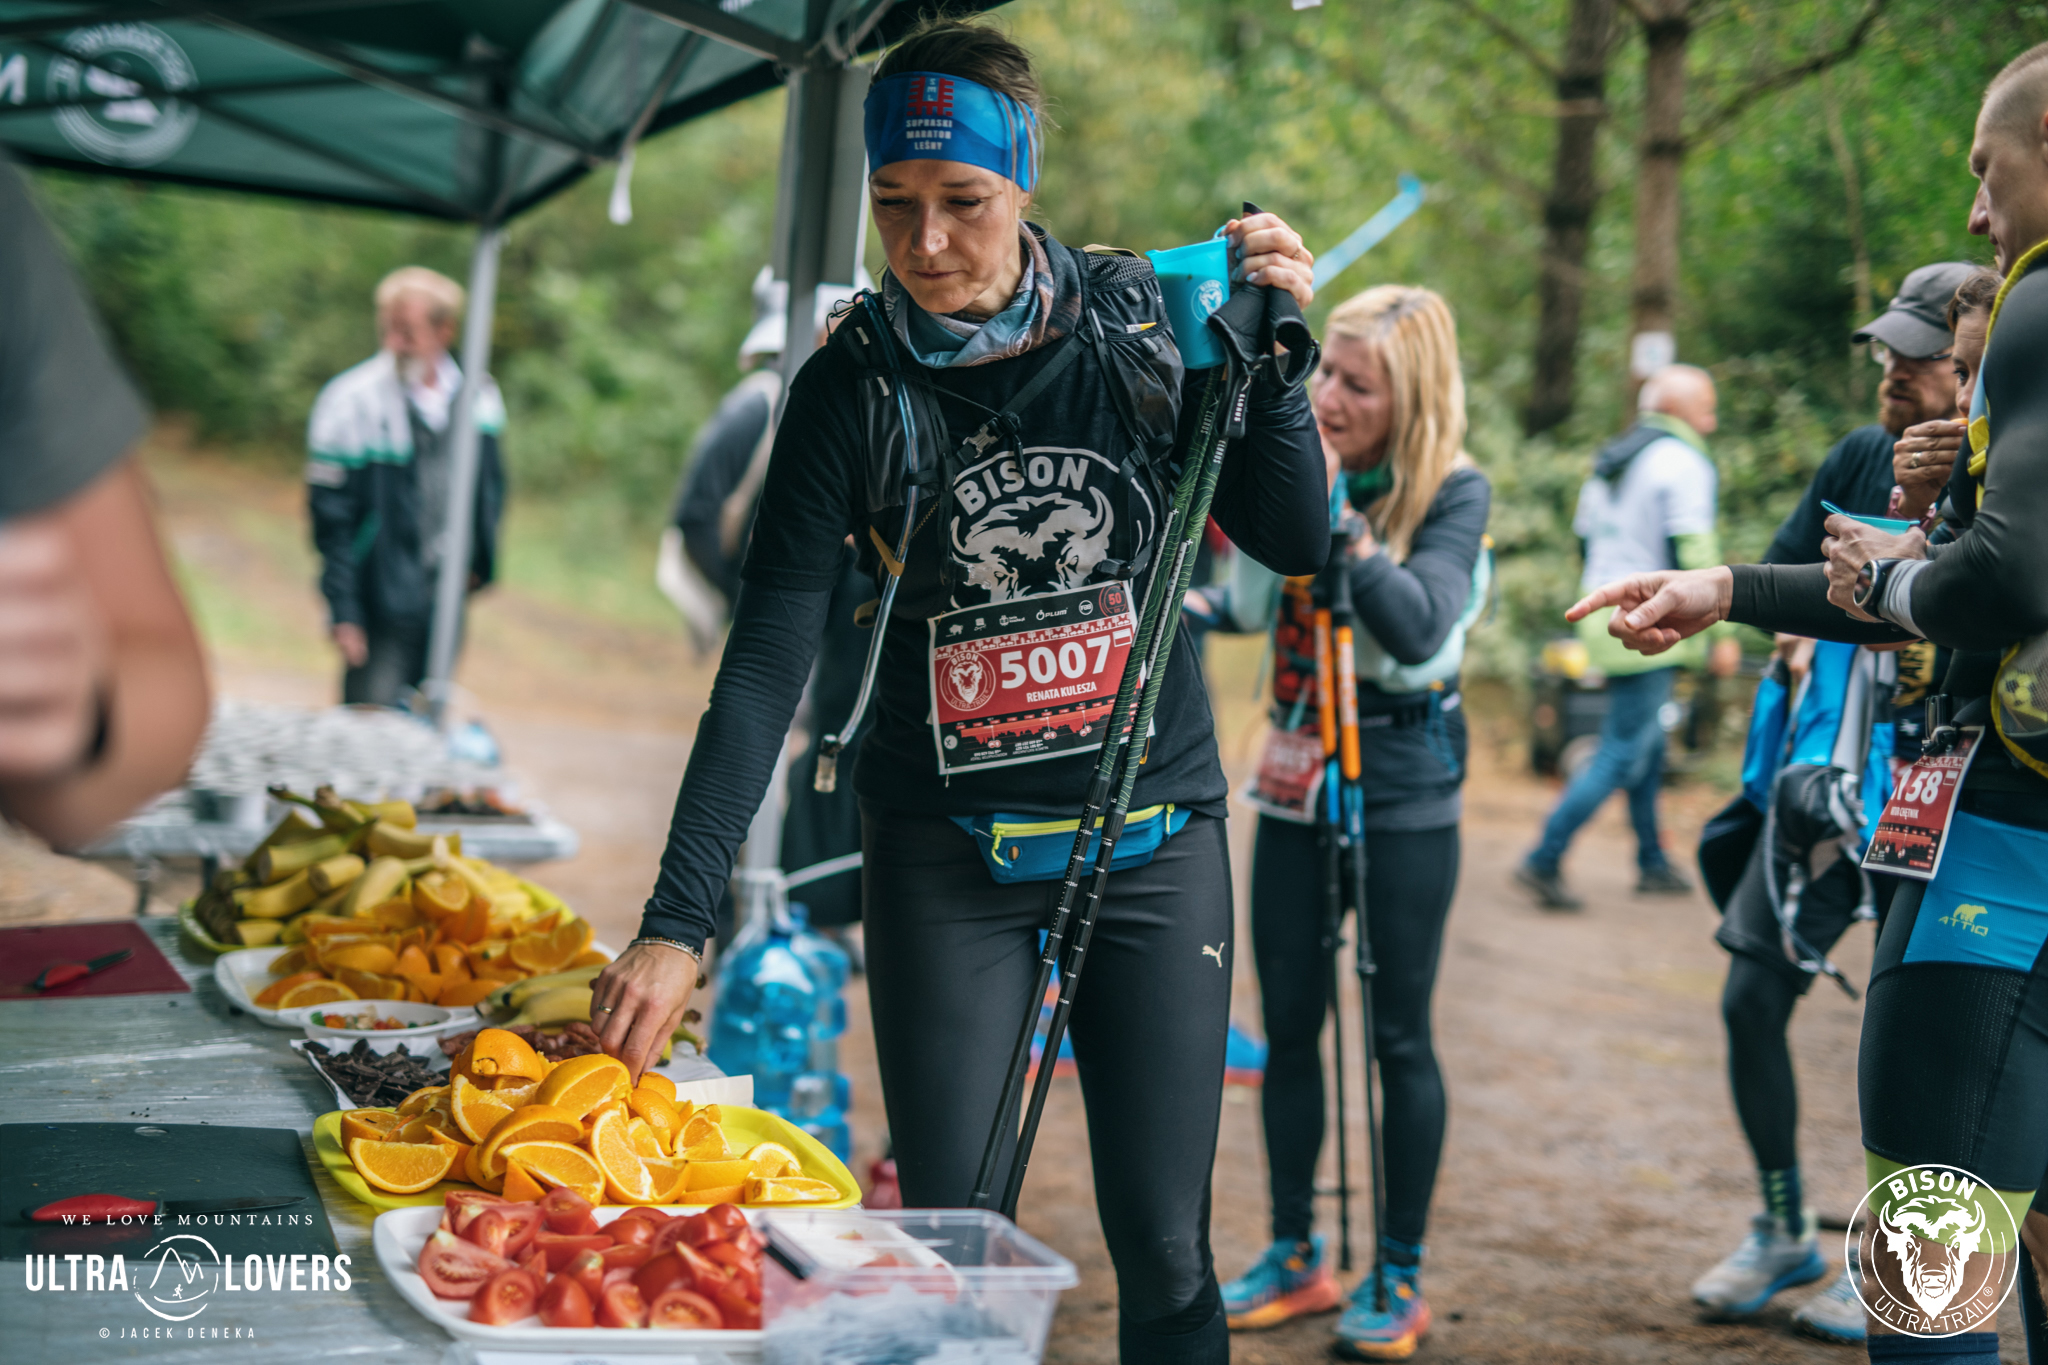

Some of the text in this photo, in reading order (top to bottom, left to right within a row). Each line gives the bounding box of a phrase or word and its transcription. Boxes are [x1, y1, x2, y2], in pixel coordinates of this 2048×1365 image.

[906, 119, 953, 129] SUPRASKI
[906, 130, 952, 139] MARATON
[914, 140, 943, 151] LEŚNY
[954, 456, 1090, 516] BISON
[1108, 592, 1122, 605] 50
[951, 652, 979, 666] BISON
[1001, 635, 1111, 689] 5007
[1026, 681, 1097, 703] RENATA KULESZA
[1938, 915, 1989, 937] ATTIQ
